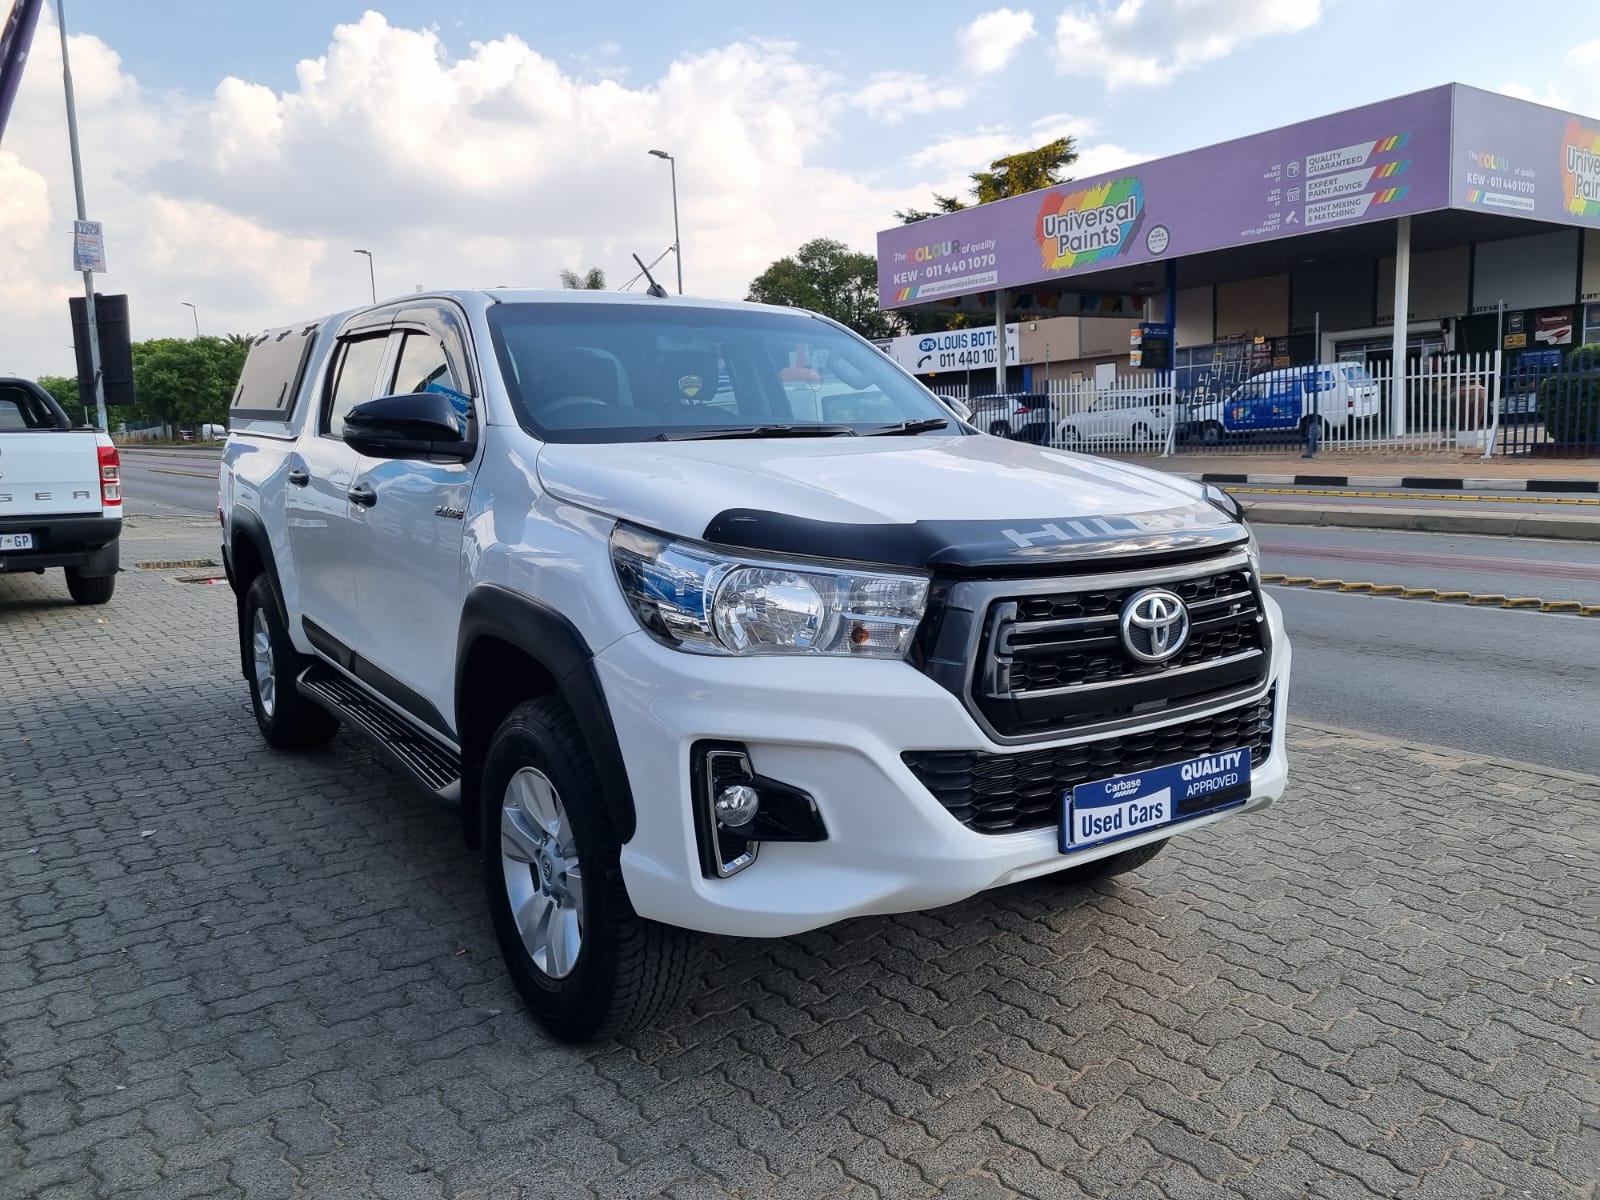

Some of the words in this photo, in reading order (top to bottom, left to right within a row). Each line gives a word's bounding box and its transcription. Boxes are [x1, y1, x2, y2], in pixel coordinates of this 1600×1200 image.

[1308, 152, 1342, 166] QUALITY
[1308, 156, 1363, 173] GUARANTEED
[1308, 178, 1338, 190] EXPERT
[1308, 188, 1331, 198] PAINT
[1332, 182, 1363, 193] ADVICE
[1466, 172, 1486, 186] KEW
[1490, 177, 1502, 189] 011
[1503, 178, 1517, 191] 440
[1518, 180, 1535, 194] 1070
[1307, 205, 1331, 215] PAINT
[1332, 198, 1361, 210] MIXING
[1314, 208, 1356, 221] MATCHING
[1043, 196, 1136, 237] Universal
[1059, 225, 1120, 255] Paints
[894, 253, 906, 262] The
[906, 240, 960, 264] COLOUR
[961, 243, 971, 254] of
[970, 240, 997, 253] quality
[893, 270, 918, 285] KEW
[926, 265, 942, 278] 011
[944, 260, 966, 274] 440
[968, 253, 996, 270] 1070
[921, 340, 935, 351] 575
[937, 334, 968, 351] LOUIS
[971, 330, 1006, 347] BOTH
[940, 352, 955, 367] 011
[958, 350, 980, 365] 440
[14, 535, 29, 547] GP
[1181, 751, 1241, 781] QUALITY
[1105, 778, 1141, 794] Carbase
[1186, 772, 1239, 797] APPROVED
[1082, 807, 1123, 838] Used
[1128, 801, 1164, 826] Cars
